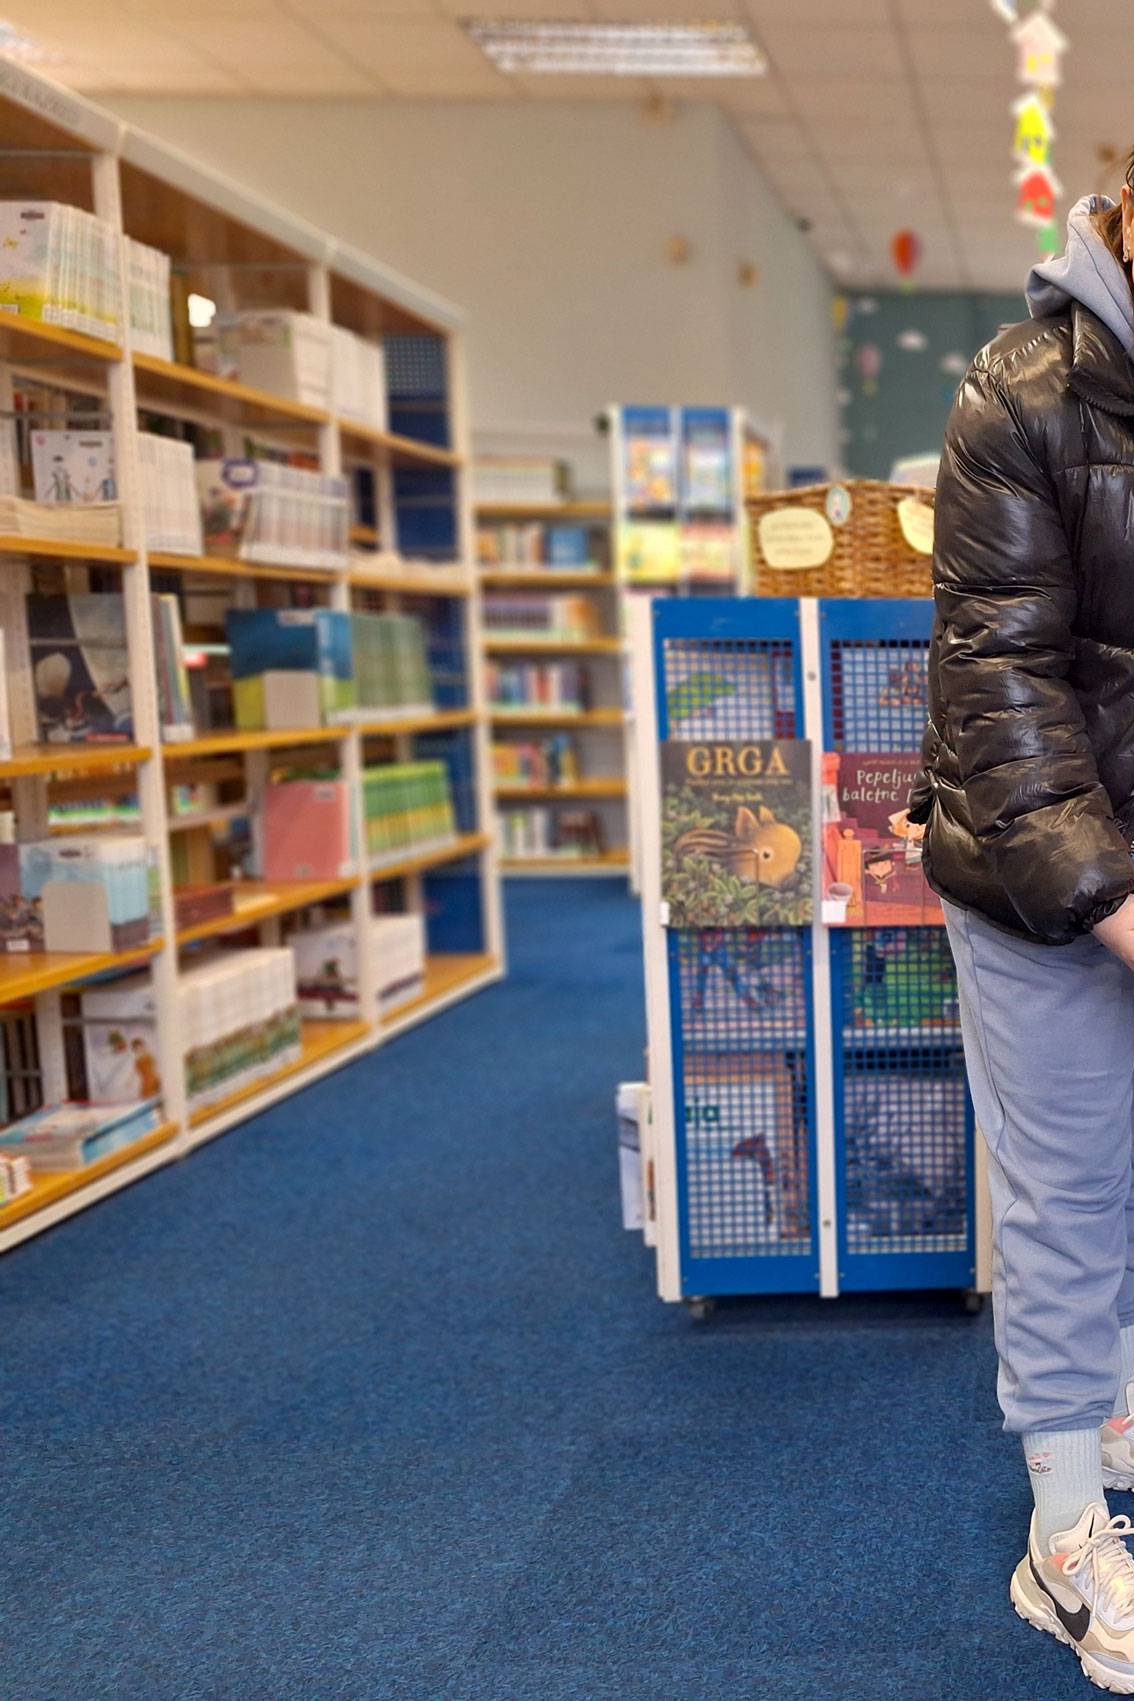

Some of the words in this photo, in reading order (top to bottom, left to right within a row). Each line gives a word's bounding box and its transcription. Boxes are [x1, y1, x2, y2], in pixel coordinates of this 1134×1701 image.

[686, 747, 790, 776] GRGA
[857, 768, 917, 790] Pepelju
[842, 787, 899, 804] baletne
